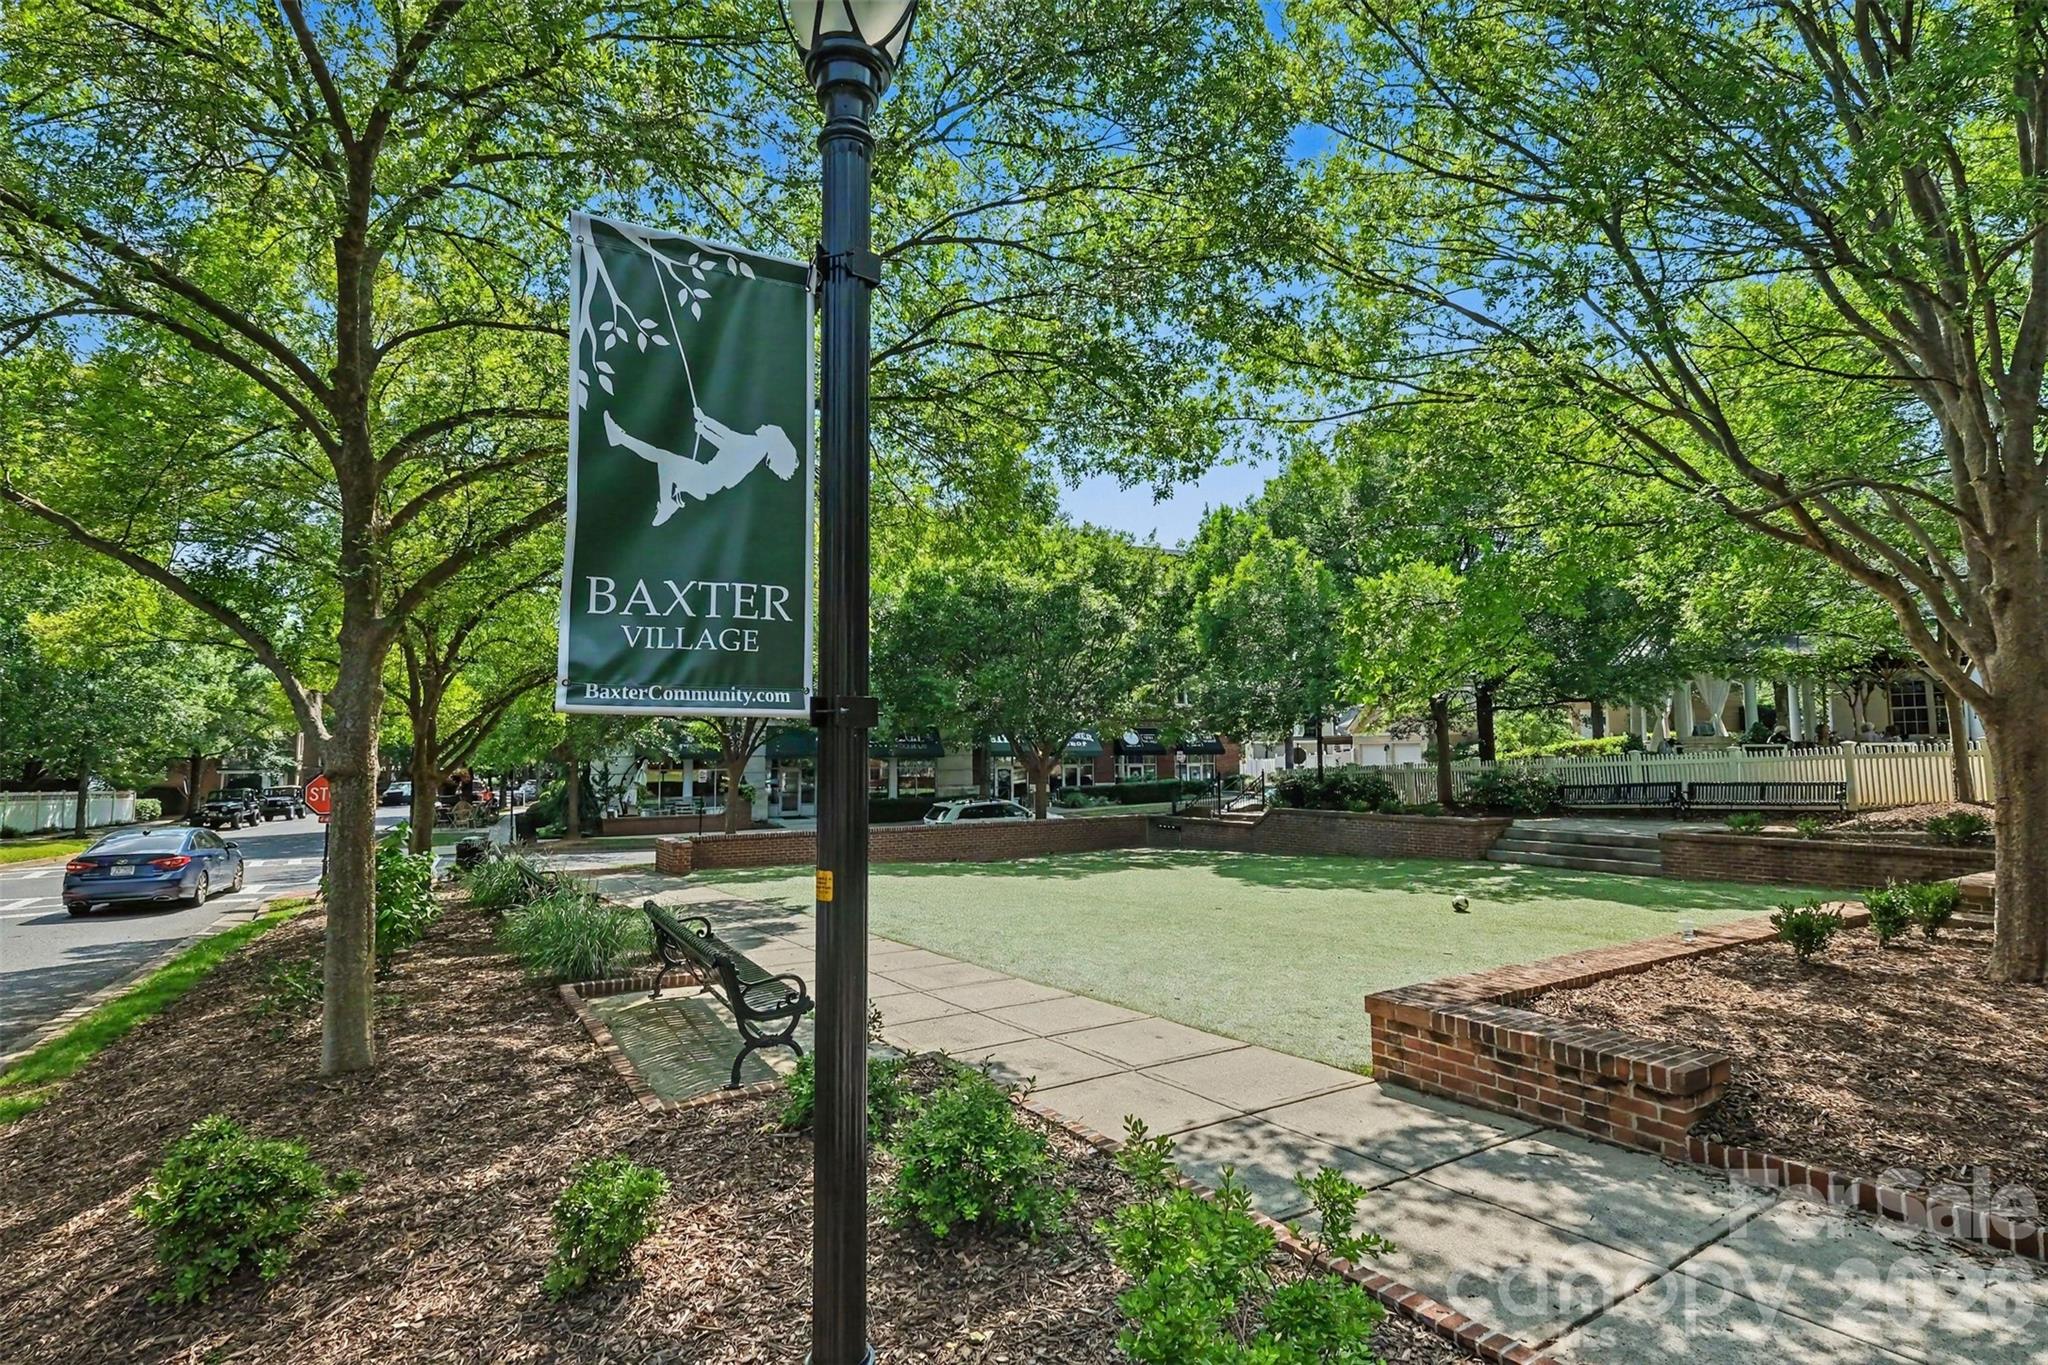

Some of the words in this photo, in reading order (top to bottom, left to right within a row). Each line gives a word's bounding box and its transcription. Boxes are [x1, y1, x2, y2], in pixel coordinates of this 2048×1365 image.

[586, 575, 793, 622] BAXTER
[620, 625, 760, 652] VILLAGE
[584, 683, 791, 706] BaxterCommunity.com
[309, 786, 330, 802] ST
